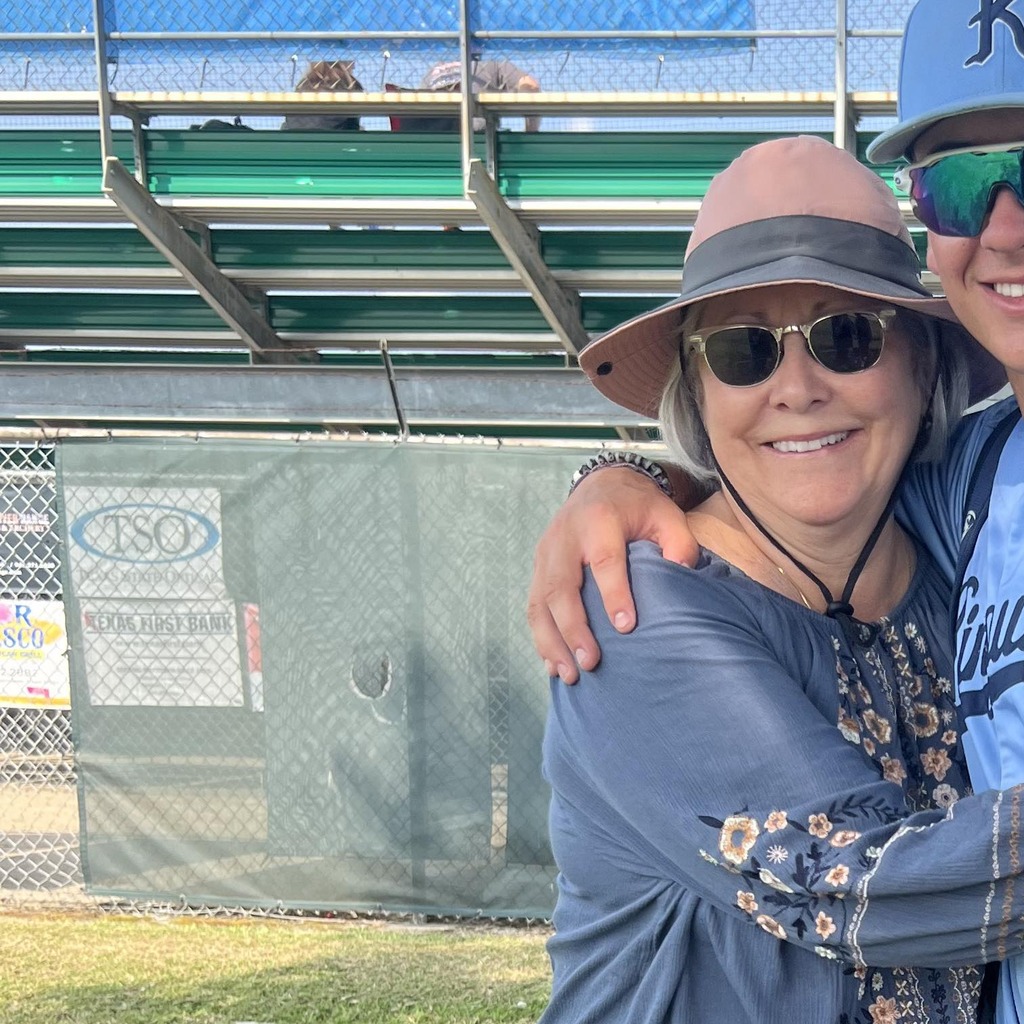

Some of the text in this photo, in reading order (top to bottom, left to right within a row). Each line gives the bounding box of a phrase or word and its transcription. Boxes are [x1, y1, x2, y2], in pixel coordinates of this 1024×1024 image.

[104, 514, 191, 555] TSO
[15, 604, 32, 627] R
[88, 614, 233, 632] TEXAS FIRST BANK
[0, 627, 44, 649] SCO
